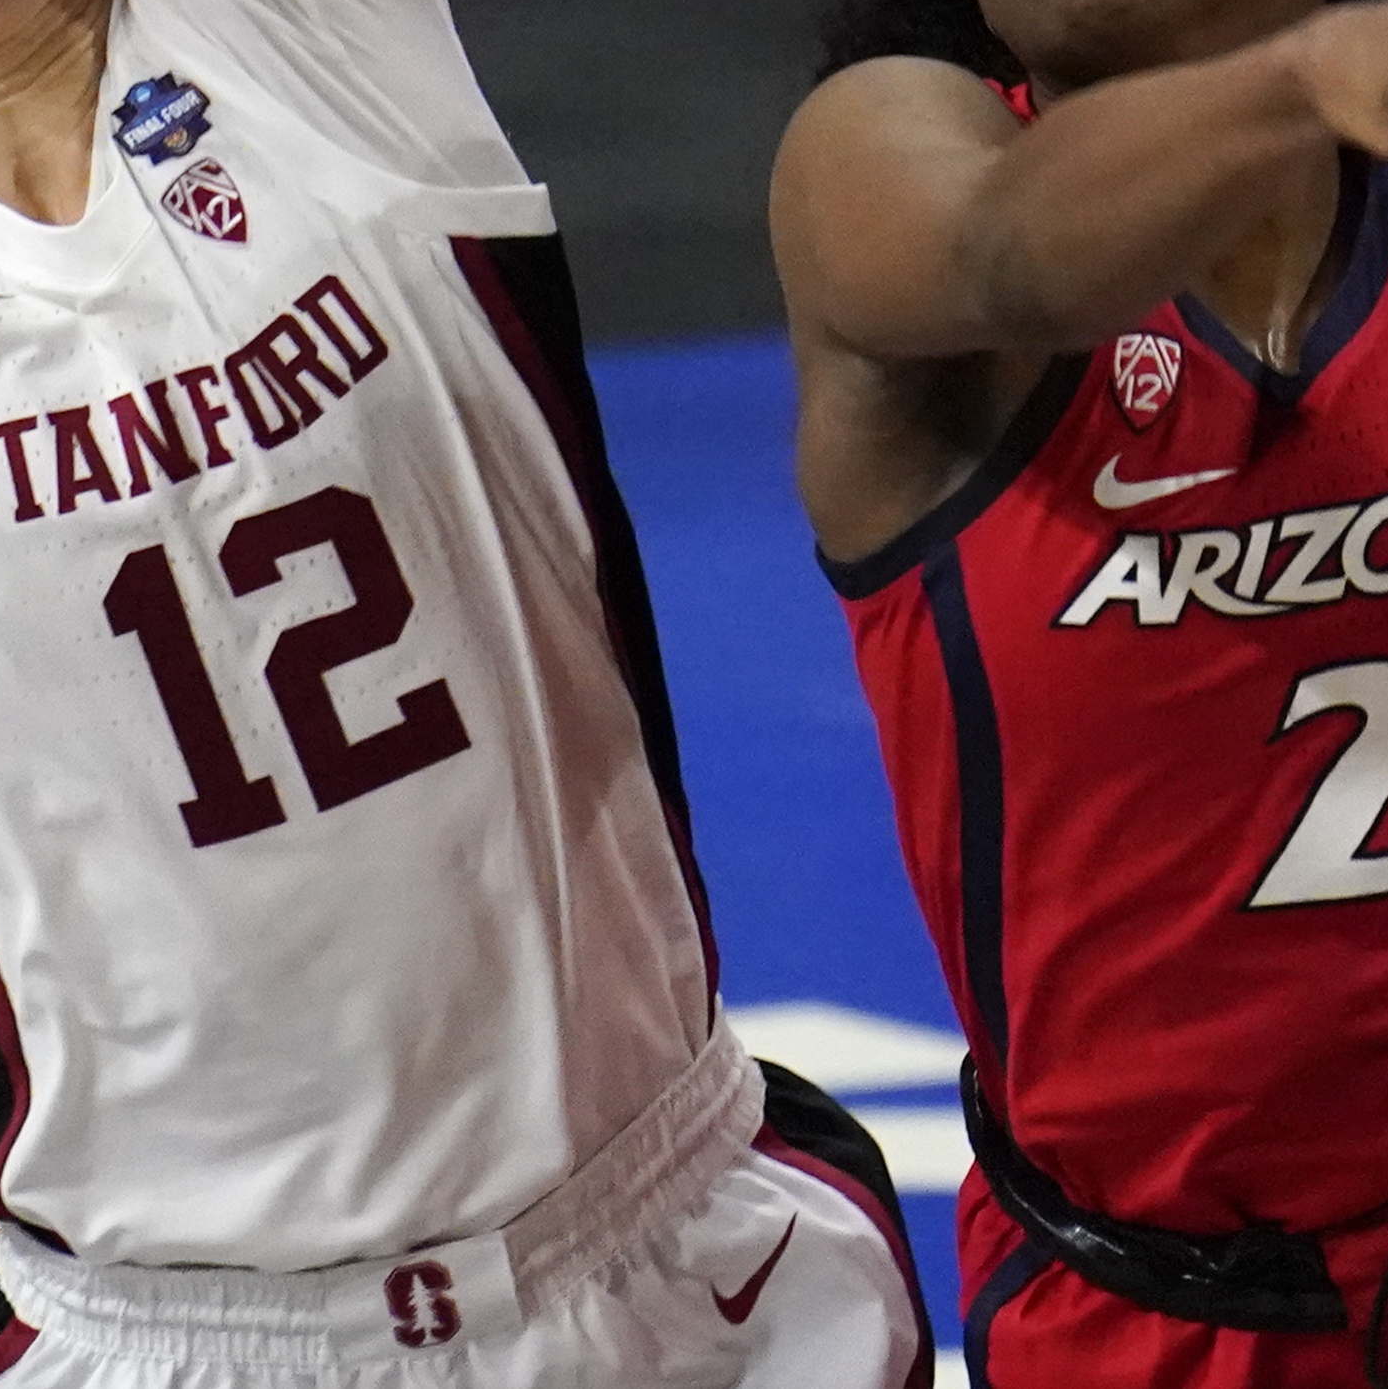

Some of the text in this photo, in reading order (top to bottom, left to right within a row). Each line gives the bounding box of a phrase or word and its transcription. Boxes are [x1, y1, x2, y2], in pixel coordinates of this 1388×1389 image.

[123, 89, 204, 149] FINAL FOUR
[1114, 333, 1181, 397] PAC
[1125, 373, 1163, 411] 12
[103, 484, 473, 849] 12
